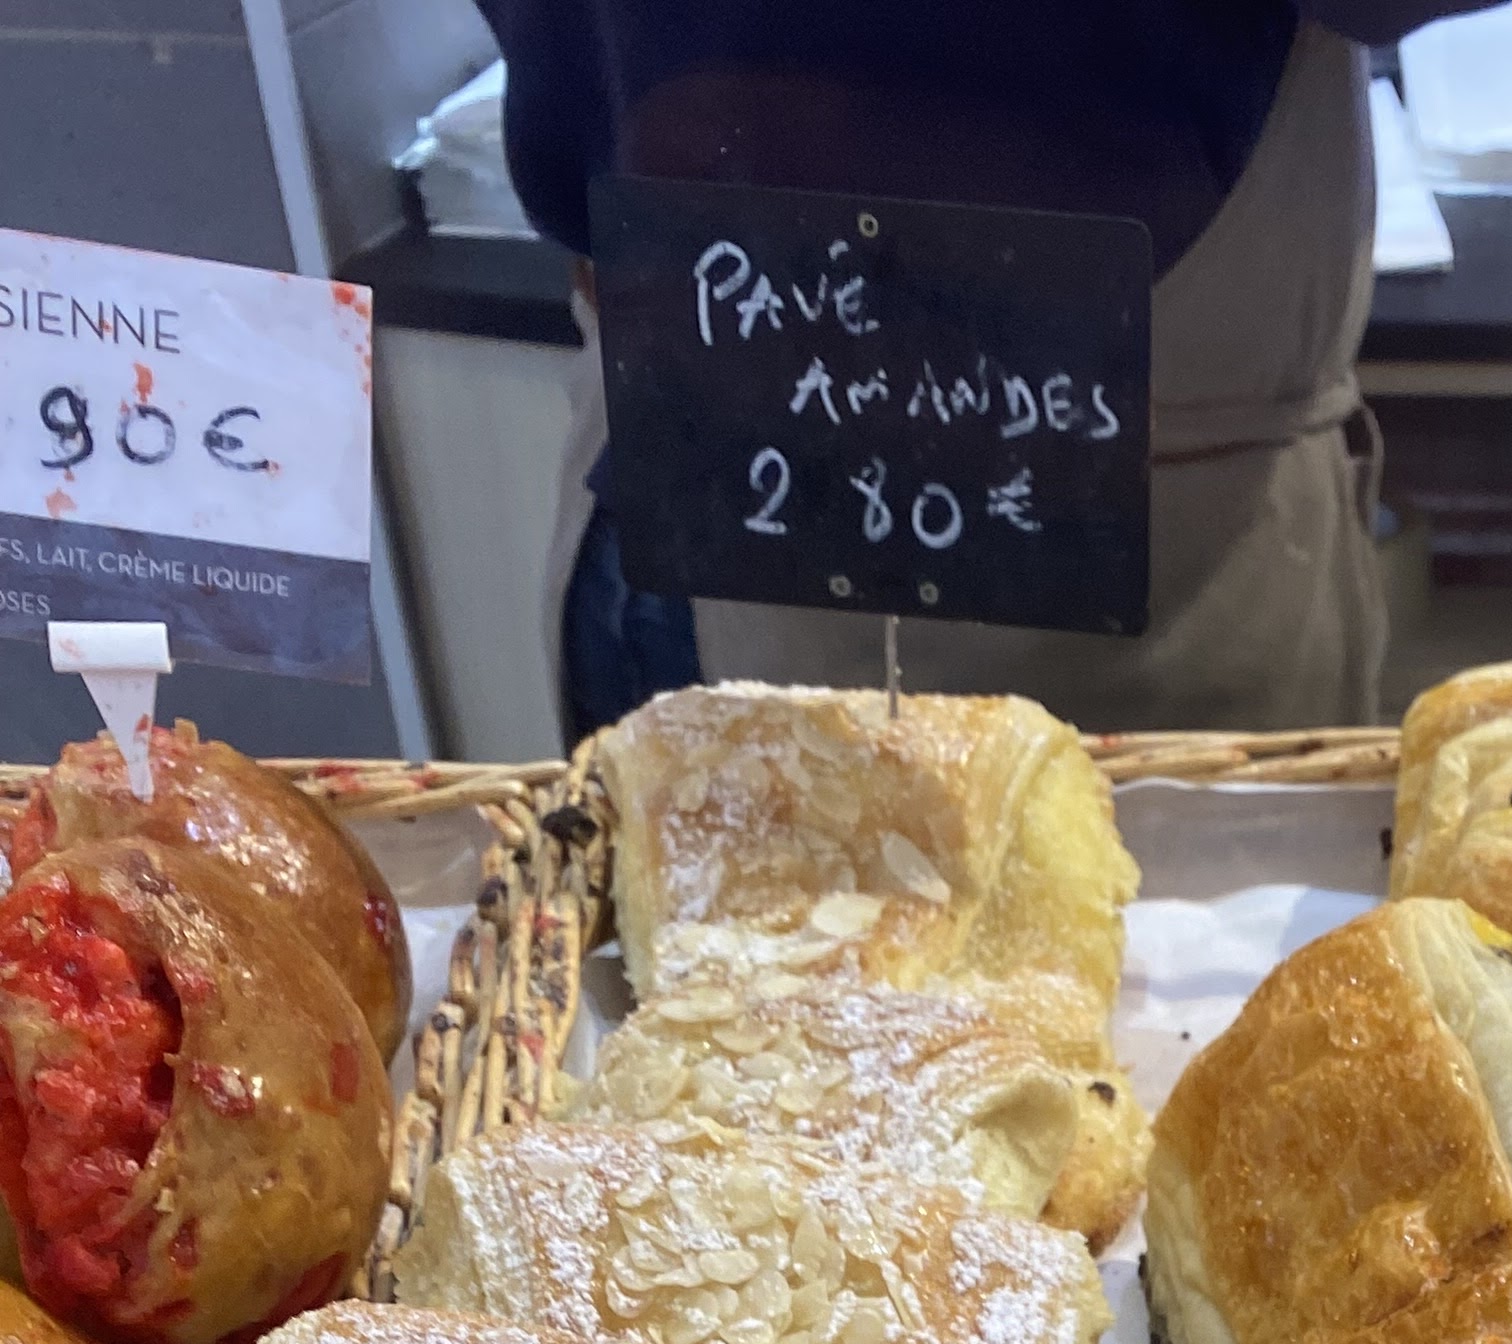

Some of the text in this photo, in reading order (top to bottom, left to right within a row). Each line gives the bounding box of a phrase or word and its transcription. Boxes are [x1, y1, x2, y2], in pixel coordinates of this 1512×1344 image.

[695, 239, 880, 346] PAVÉ
[98, 549, 187, 585] CRÈME
[192, 564, 292, 598] LIQUIDE
